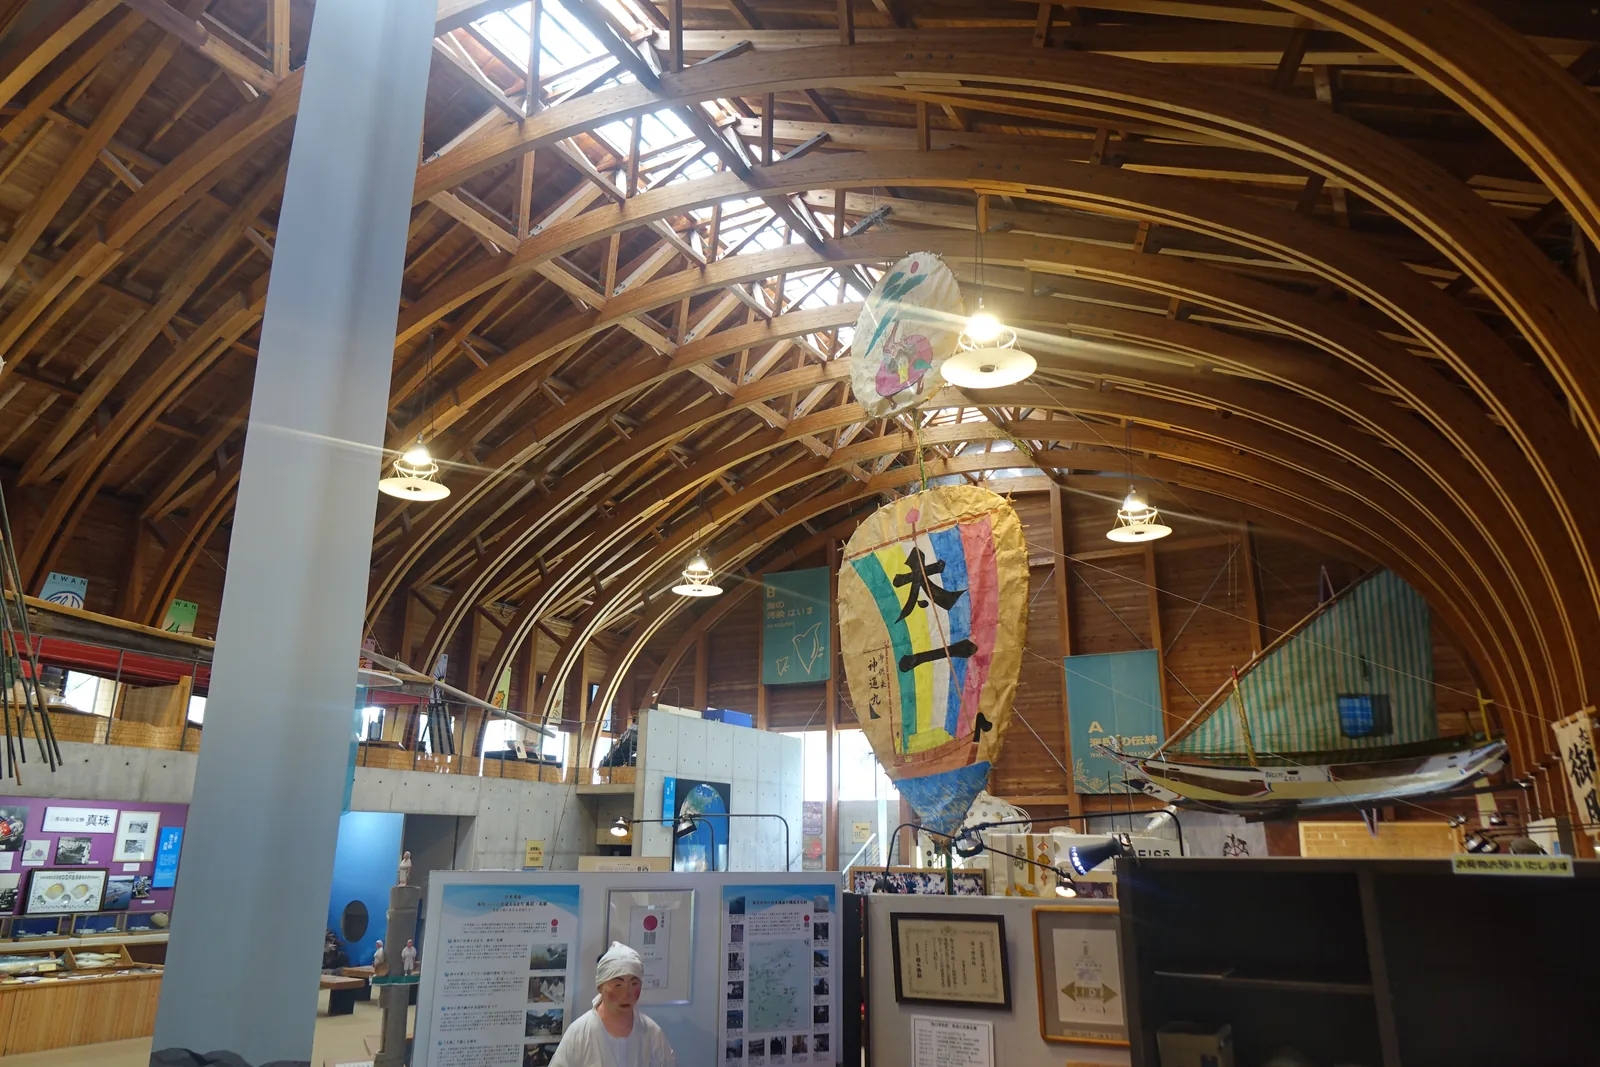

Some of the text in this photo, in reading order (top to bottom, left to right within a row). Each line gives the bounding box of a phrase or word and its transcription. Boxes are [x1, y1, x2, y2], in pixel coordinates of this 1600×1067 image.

[766, 586, 776, 598] B
[893, 546, 978, 673] 太一
[1088, 721, 1104, 733] A
[85, 814, 110, 827] 真珠
